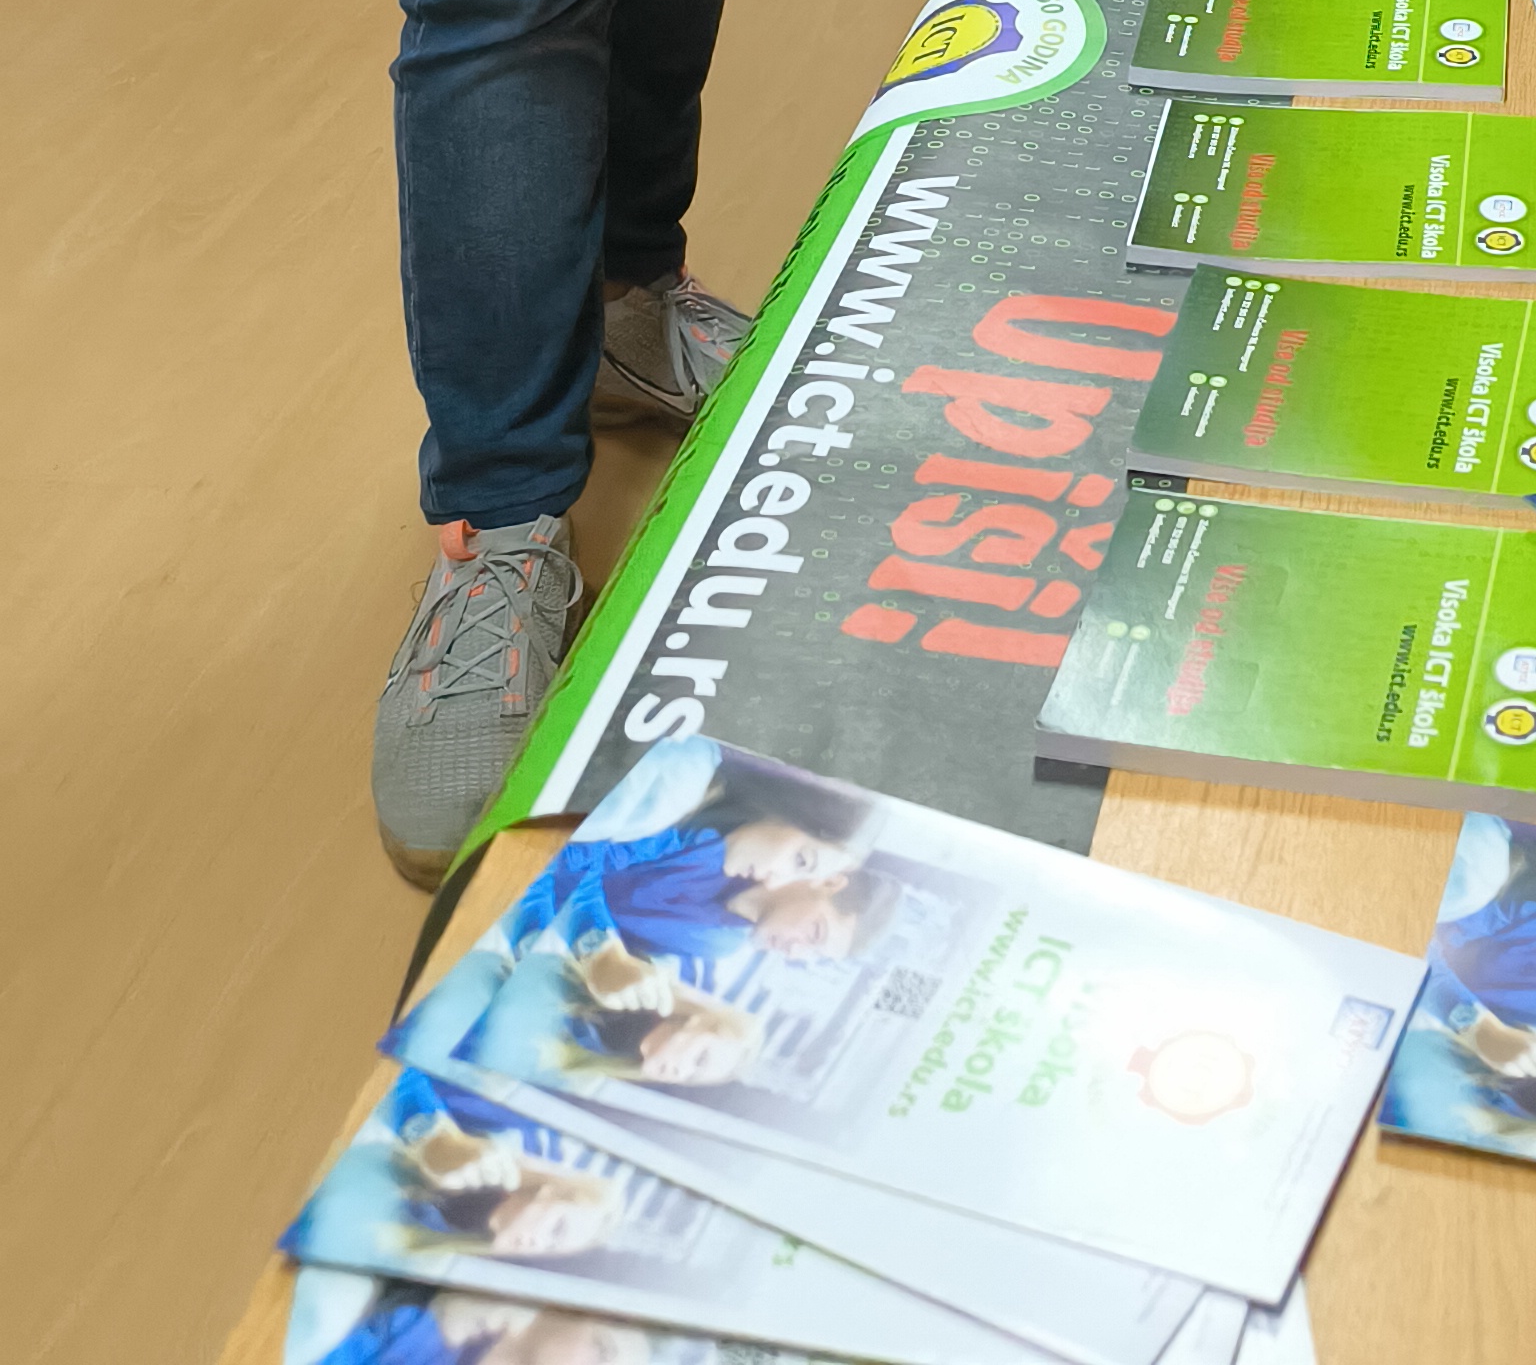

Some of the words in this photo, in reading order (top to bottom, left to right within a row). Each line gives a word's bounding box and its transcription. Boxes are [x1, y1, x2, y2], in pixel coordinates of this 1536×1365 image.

[914, 13, 965, 64] ICT
[995, 19, 1067, 85] GODINA
[1387, 42, 1410, 71] škola
[1390, 23, 1411, 43] ICT
[1241, 179, 1269, 201] od
[1426, 155, 1451, 198] Visoka
[1395, 184, 1416, 257] www.ict.edu.rs
[1424, 198, 1447, 222] ICT
[1420, 222, 1446, 259] škola
[1264, 362, 1293, 388] od
[1471, 342, 1504, 396] Visoka
[1425, 377, 1460, 469] www.ict.edu.rs
[1466, 397, 1498, 426] ICT
[624, 174, 960, 743] www.ict.edu.rs
[1453, 425, 1488, 473] škola
[840, 293, 1178, 667] Upiši!
[1194, 607, 1227, 638] od
[1430, 579, 1469, 648] Visoka
[1375, 623, 1418, 744] www.ict.edu.rs
[1422, 651, 1455, 688] ICT
[1407, 687, 1448, 748] škola
[1509, 712, 1525, 732] ICT
[1014, 934, 1076, 1003] ICT
[888, 904, 1029, 1118] www.ict.edu.rs
[937, 1005, 1032, 1115] škola
